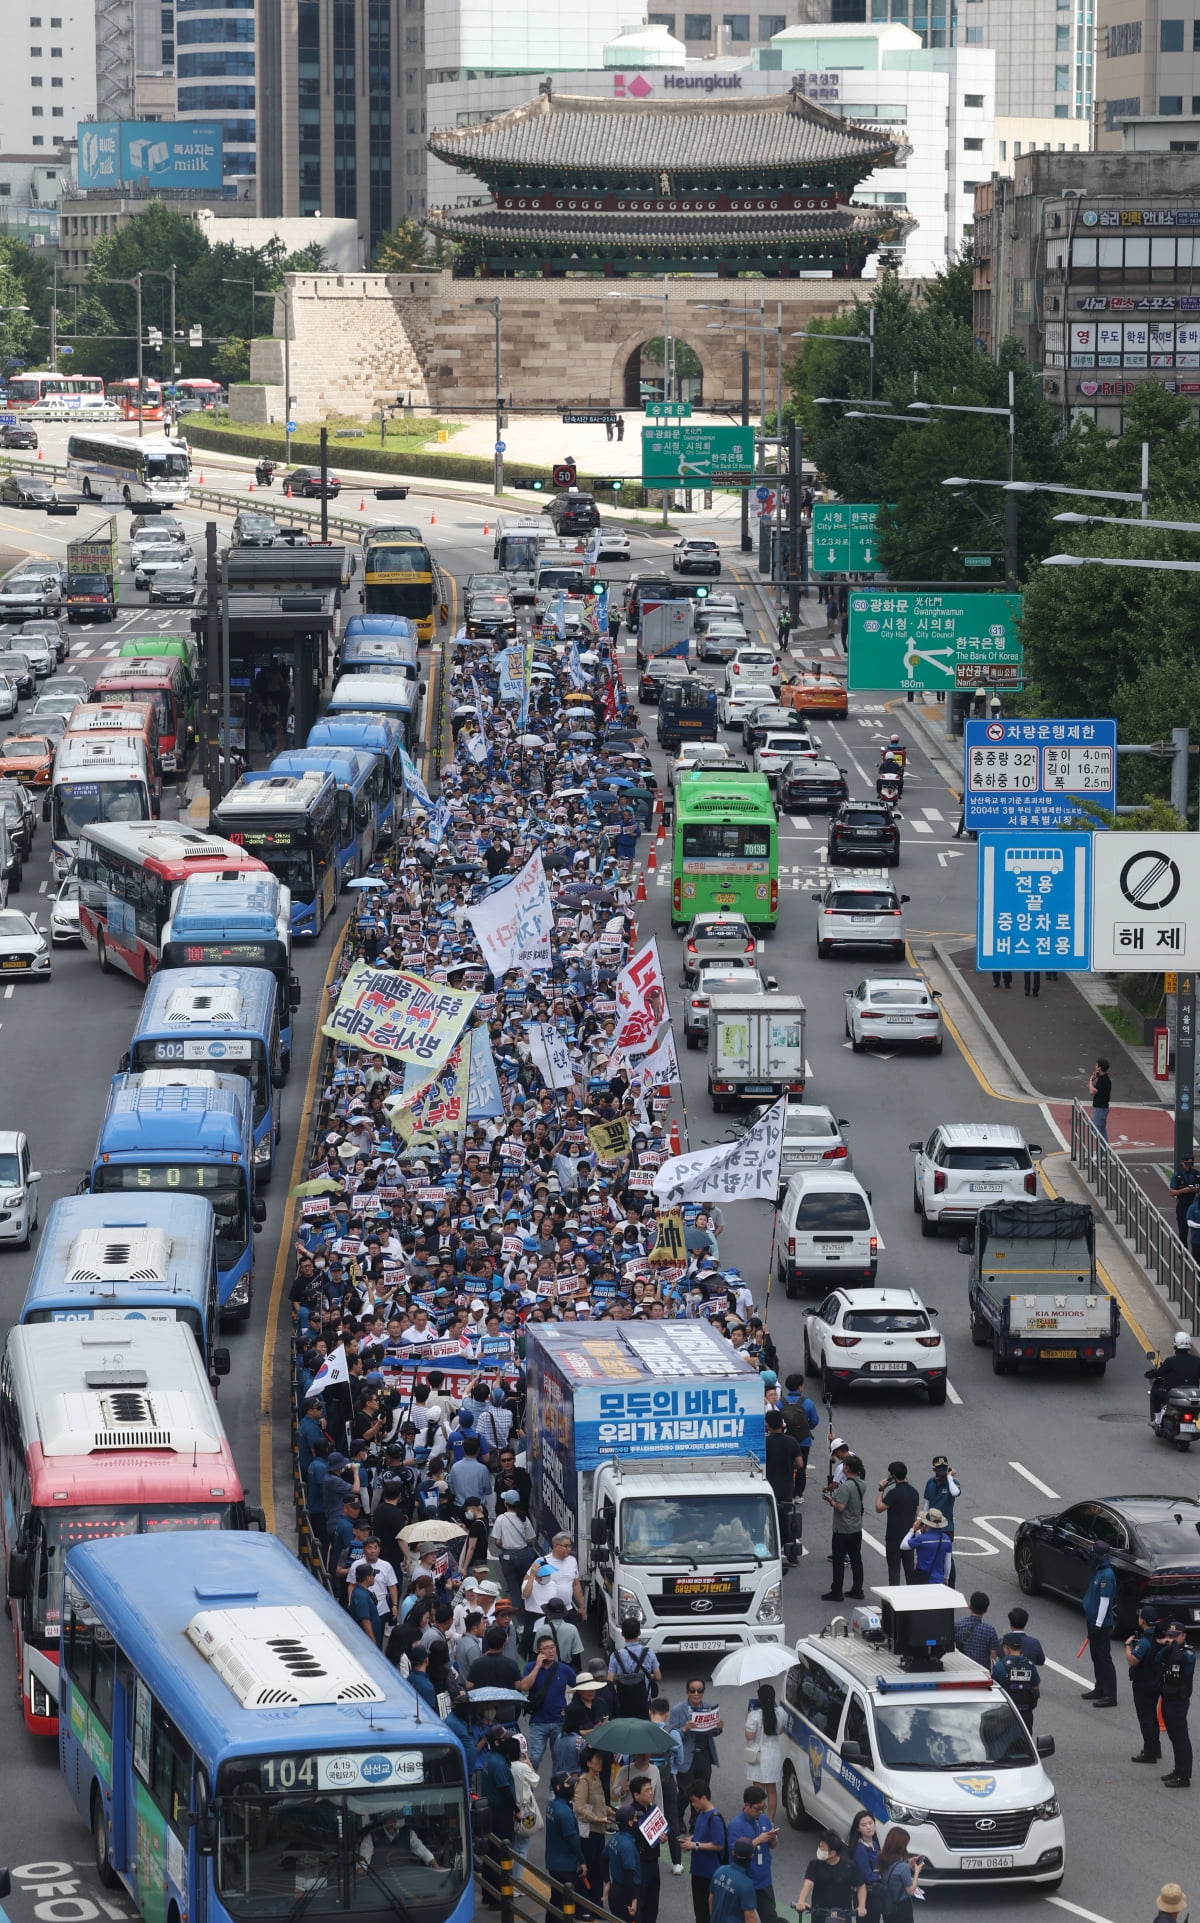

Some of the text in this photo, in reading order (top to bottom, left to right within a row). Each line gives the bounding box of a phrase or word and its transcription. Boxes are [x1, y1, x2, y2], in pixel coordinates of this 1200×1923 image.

[664, 75, 742, 92] Heungkuk
[174, 144, 215, 156] 복사지는
[1137, 297, 1175, 310] 스포츠
[1077, 330, 1089, 344] 영
[1100, 331, 1119, 343] 무도
[1127, 331, 1145, 343] 학원
[1179, 331, 1198, 343] 룸바
[652, 406, 685, 414] 숭례문
[656, 430, 680, 439] 광화문
[712, 454, 744, 463] 한국은행
[559, 472, 570, 482] 50
[823, 513, 843, 522] 시청
[856, 597, 942, 613] 50 광화문 光化門
[914, 607, 964, 616] Gwanghwamun
[881, 631, 893, 639] City
[916, 631, 928, 639] City
[993, 626, 1002, 635] 31
[956, 637, 1006, 650] 한국은행
[956, 652, 1019, 660] The Bank Of Korea
[901, 680, 924, 689] 180m
[1008, 725, 1096, 740] 차량운행제한
[974, 752, 1009, 766] 총중량
[1048, 750, 1110, 761] 높이 4.0m
[1048, 764, 1110, 776] 길이 16.7m
[973, 773, 1008, 788] 축하중
[1055, 777, 1109, 789] 폭 2.5m
[1008, 816, 1072, 826] 서울특별시장
[230, 833, 244, 845] 421
[745, 845, 767, 855] 7013B
[1016, 876, 1054, 894] 전용
[1026, 895, 1044, 911] 끝
[998, 913, 1071, 932] 중앙차로
[997, 936, 1071, 956] 버스전용
[188, 946, 204, 960] 100
[1184, 979, 1191, 990] 4
[1183, 1005, 1191, 1035] 서울역
[158, 1044, 183, 1058] 502
[138, 1168, 205, 1186] 501
[601, 1389, 745, 1419] 모두의 바다,
[599, 1419, 744, 1444] 우리가 지킵시다!
[675, 1584, 709, 1594] 해양투기
[710, 1583, 731, 1593] 반대!
[703, 1642, 722, 1650] 0279
[264, 1759, 314, 1788] 104
[334, 1761, 423, 1775] 4.19 삼선교 서울역
[329, 1771, 356, 1780] 국립묘지
[986, 1858, 1009, 1866] 0846
